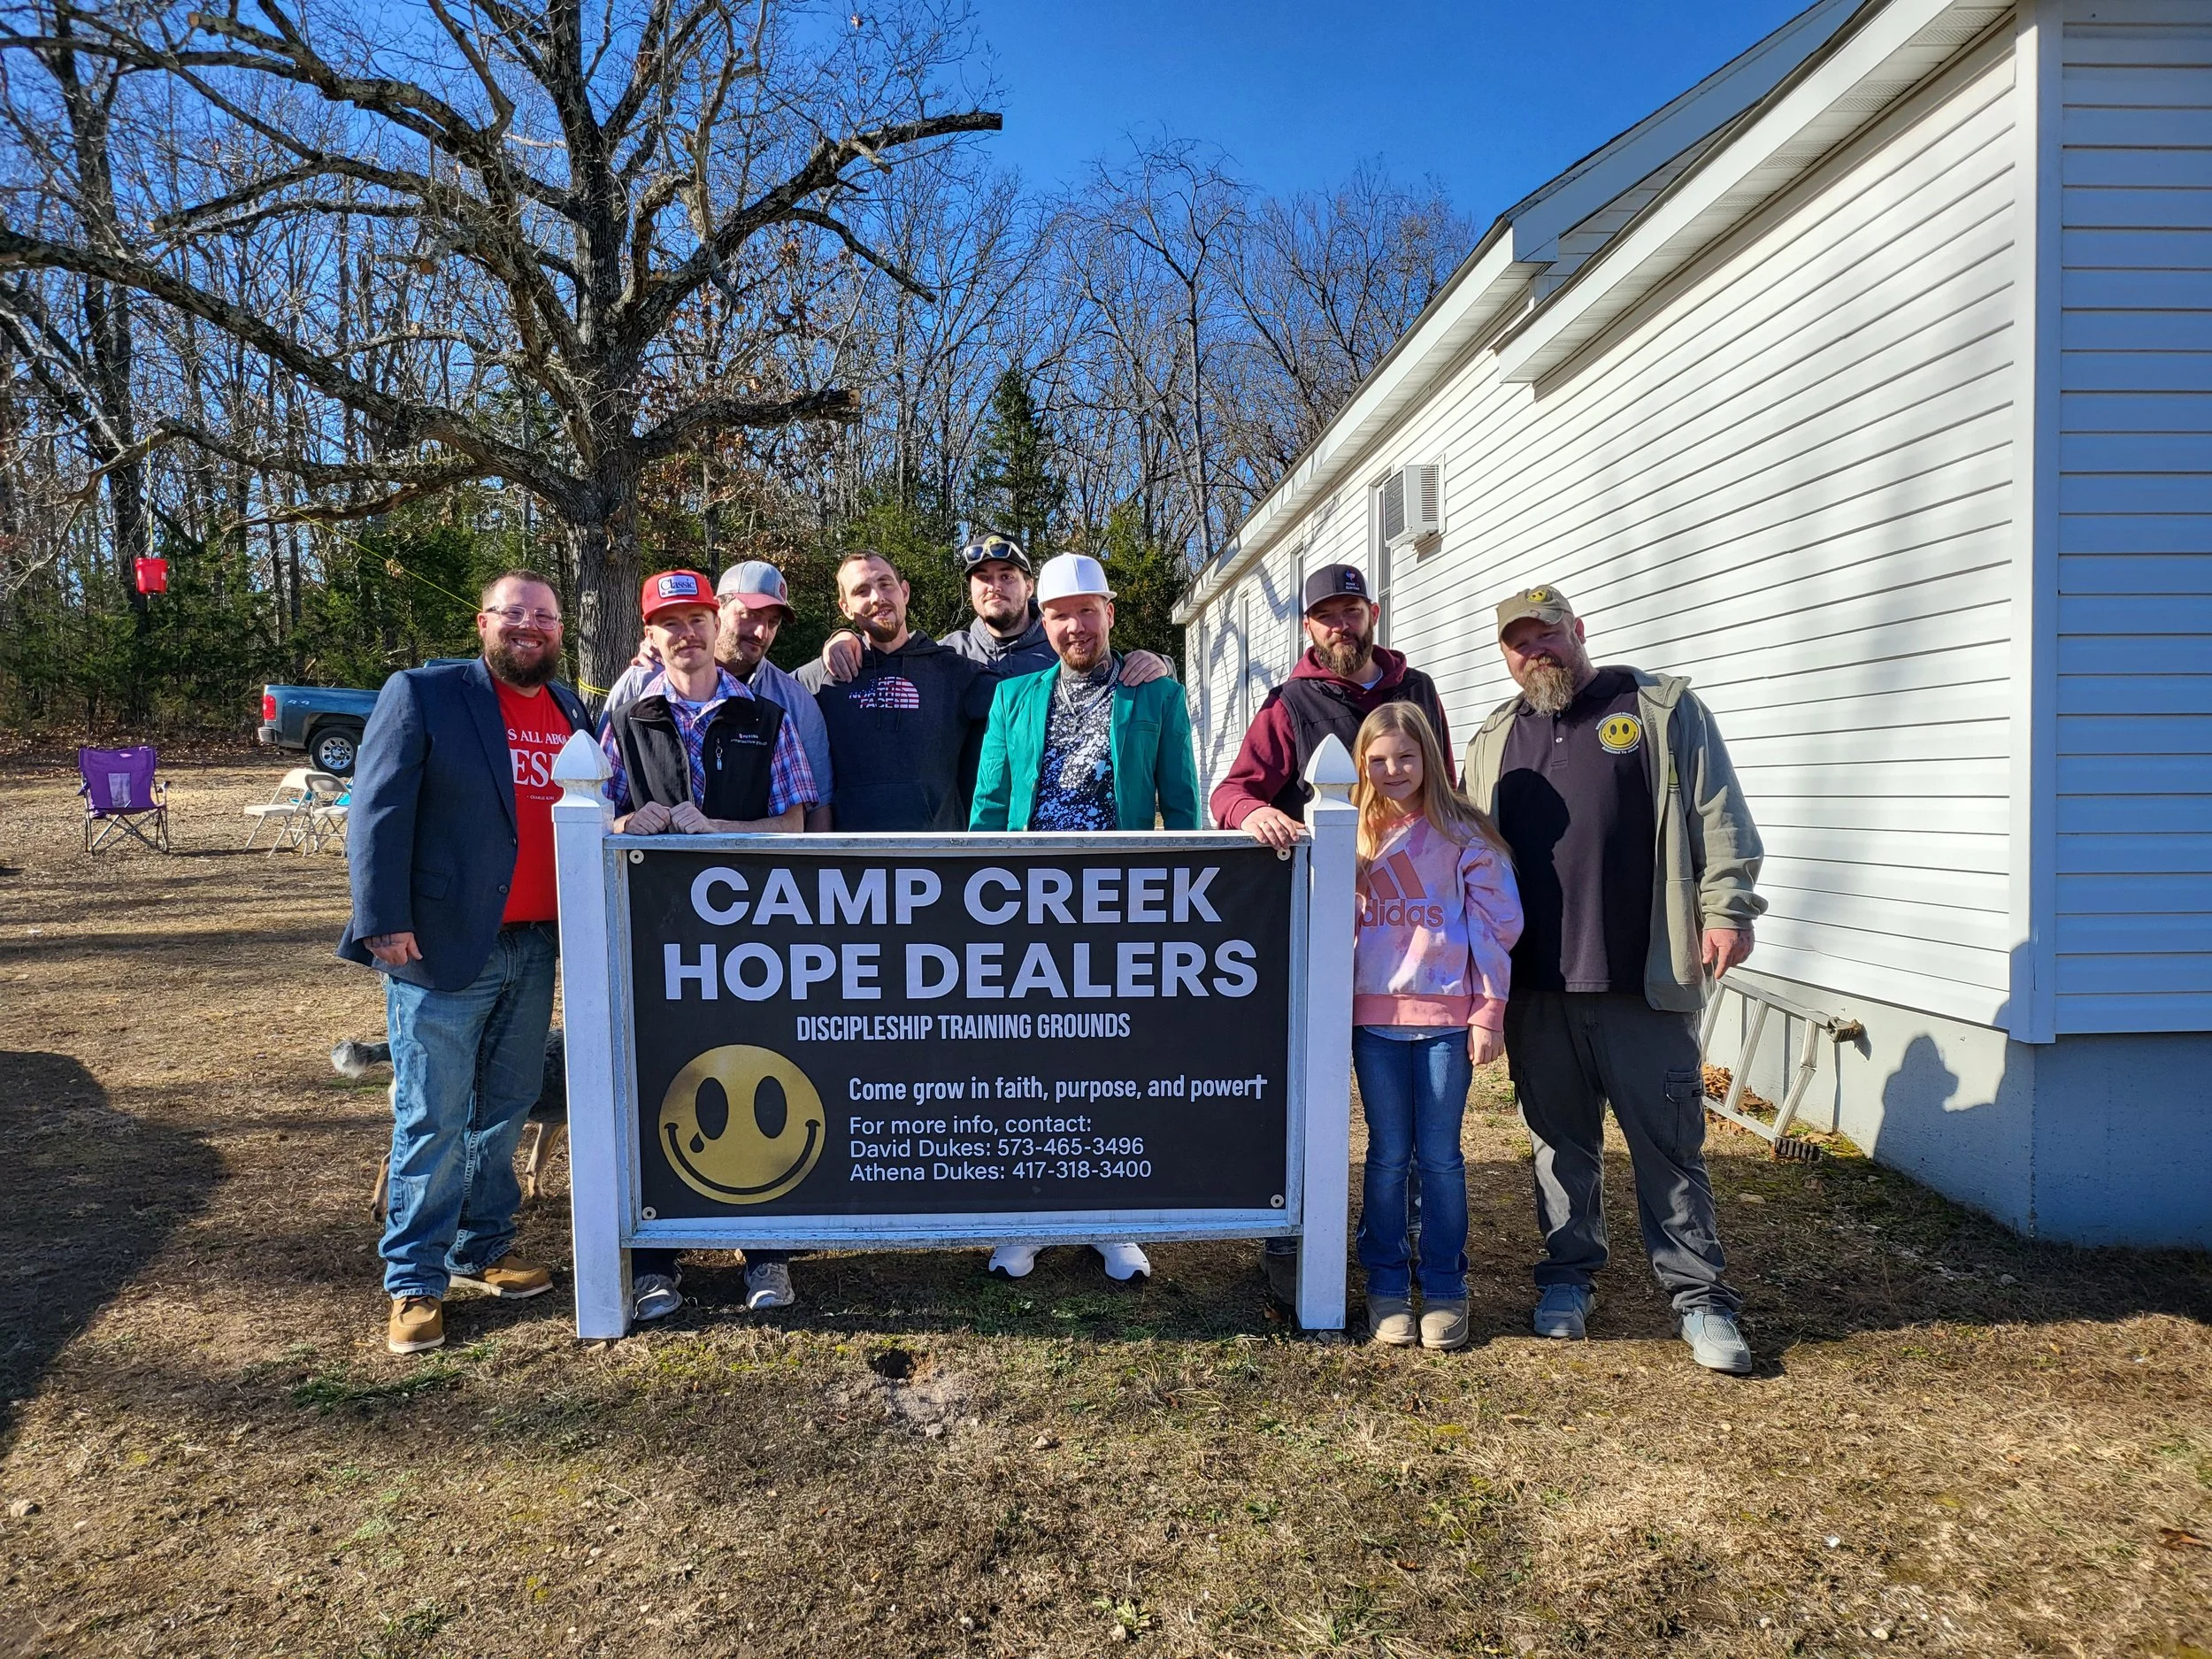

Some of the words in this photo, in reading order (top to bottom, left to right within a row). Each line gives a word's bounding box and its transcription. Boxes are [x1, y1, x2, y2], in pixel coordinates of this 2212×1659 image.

[661, 578, 695, 590] Classic
[520, 730, 543, 743] ALL
[690, 867, 941, 925] CAMP
[964, 867, 1223, 925] CREEK
[1361, 898, 1444, 927] didas
[664, 943, 881, 1001] HOPE
[905, 940, 1258, 999] DEALERS
[797, 1015, 933, 1041] DISCIPLESHIP
[938, 1014, 1032, 1040] TRAINING
[1037, 1013, 1131, 1039] GROUNDS
[849, 1077, 907, 1101] Come
[913, 1082, 965, 1103] grow
[971, 1077, 989, 1099] in
[995, 1076, 1048, 1101] faith,
[1056, 1080, 1142, 1103] purpose,
[1148, 1074, 1185, 1097] and
[849, 1117, 885, 1133] For
[891, 1119, 947, 1133] more
[953, 1115, 999, 1136] info,
[1005, 1116, 1092, 1133] contact:
[850, 1139, 910, 1157] David
[918, 1139, 991, 1157] Dukes:
[997, 1137, 1144, 1156] 573-465-3496
[849, 1162, 925, 1181] Athena
[933, 1162, 1005, 1180] Dukes:
[1012, 1161, 1152, 1179] 417-318-3400
